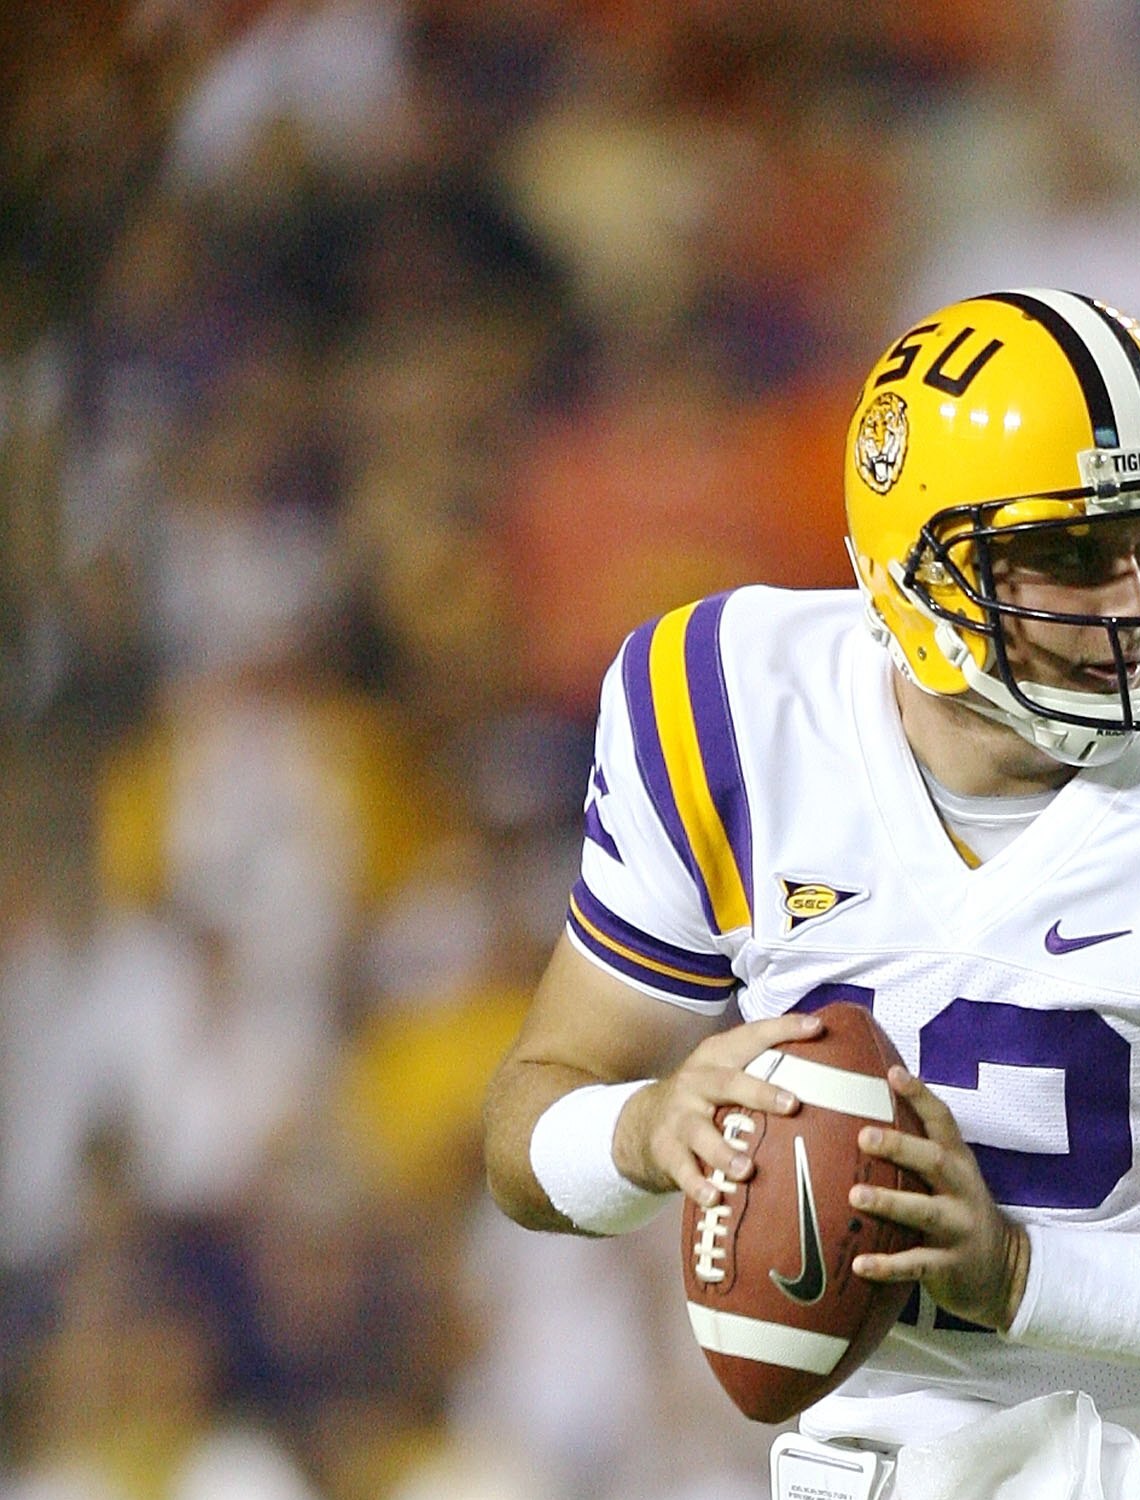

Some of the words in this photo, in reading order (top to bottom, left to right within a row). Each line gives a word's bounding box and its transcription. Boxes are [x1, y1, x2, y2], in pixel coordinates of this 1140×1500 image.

[872, 322, 1005, 398] SU
[792, 898, 828, 910] SEC
[783, 983, 1132, 1333] 2
